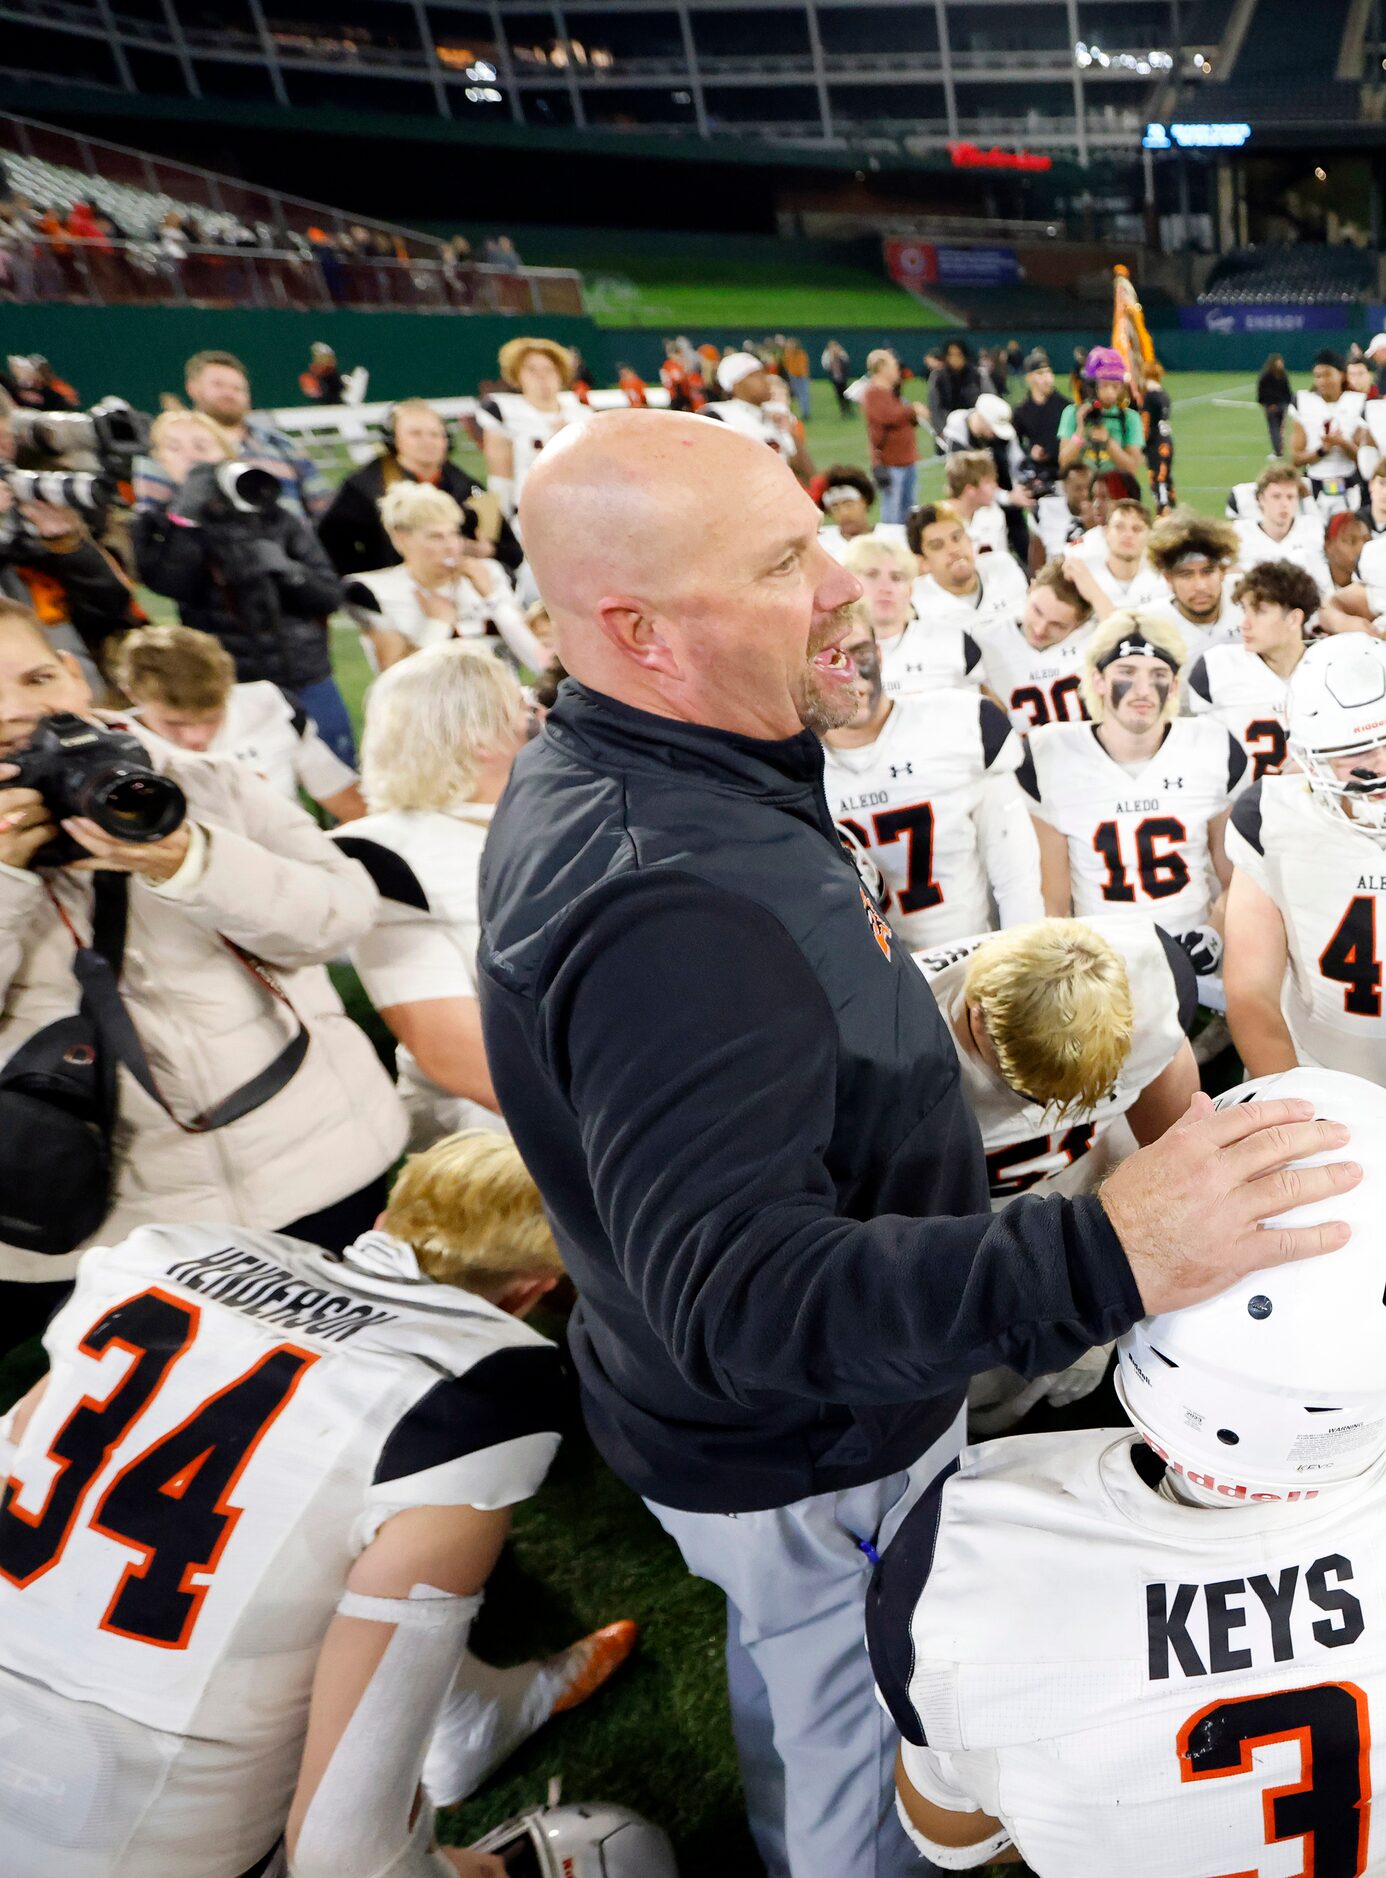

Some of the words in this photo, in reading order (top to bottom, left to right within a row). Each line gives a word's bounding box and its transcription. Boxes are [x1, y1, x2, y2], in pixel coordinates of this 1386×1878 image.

[840, 789, 889, 813] ALEDO
[1116, 798, 1159, 814] ALEDO
[1093, 816, 1191, 904] 16
[167, 1247, 400, 1343] HENDERSON
[0, 1286, 322, 1649] 34
[1146, 1552, 1366, 1681] KEYS
[1176, 1680, 1372, 1878] 3
